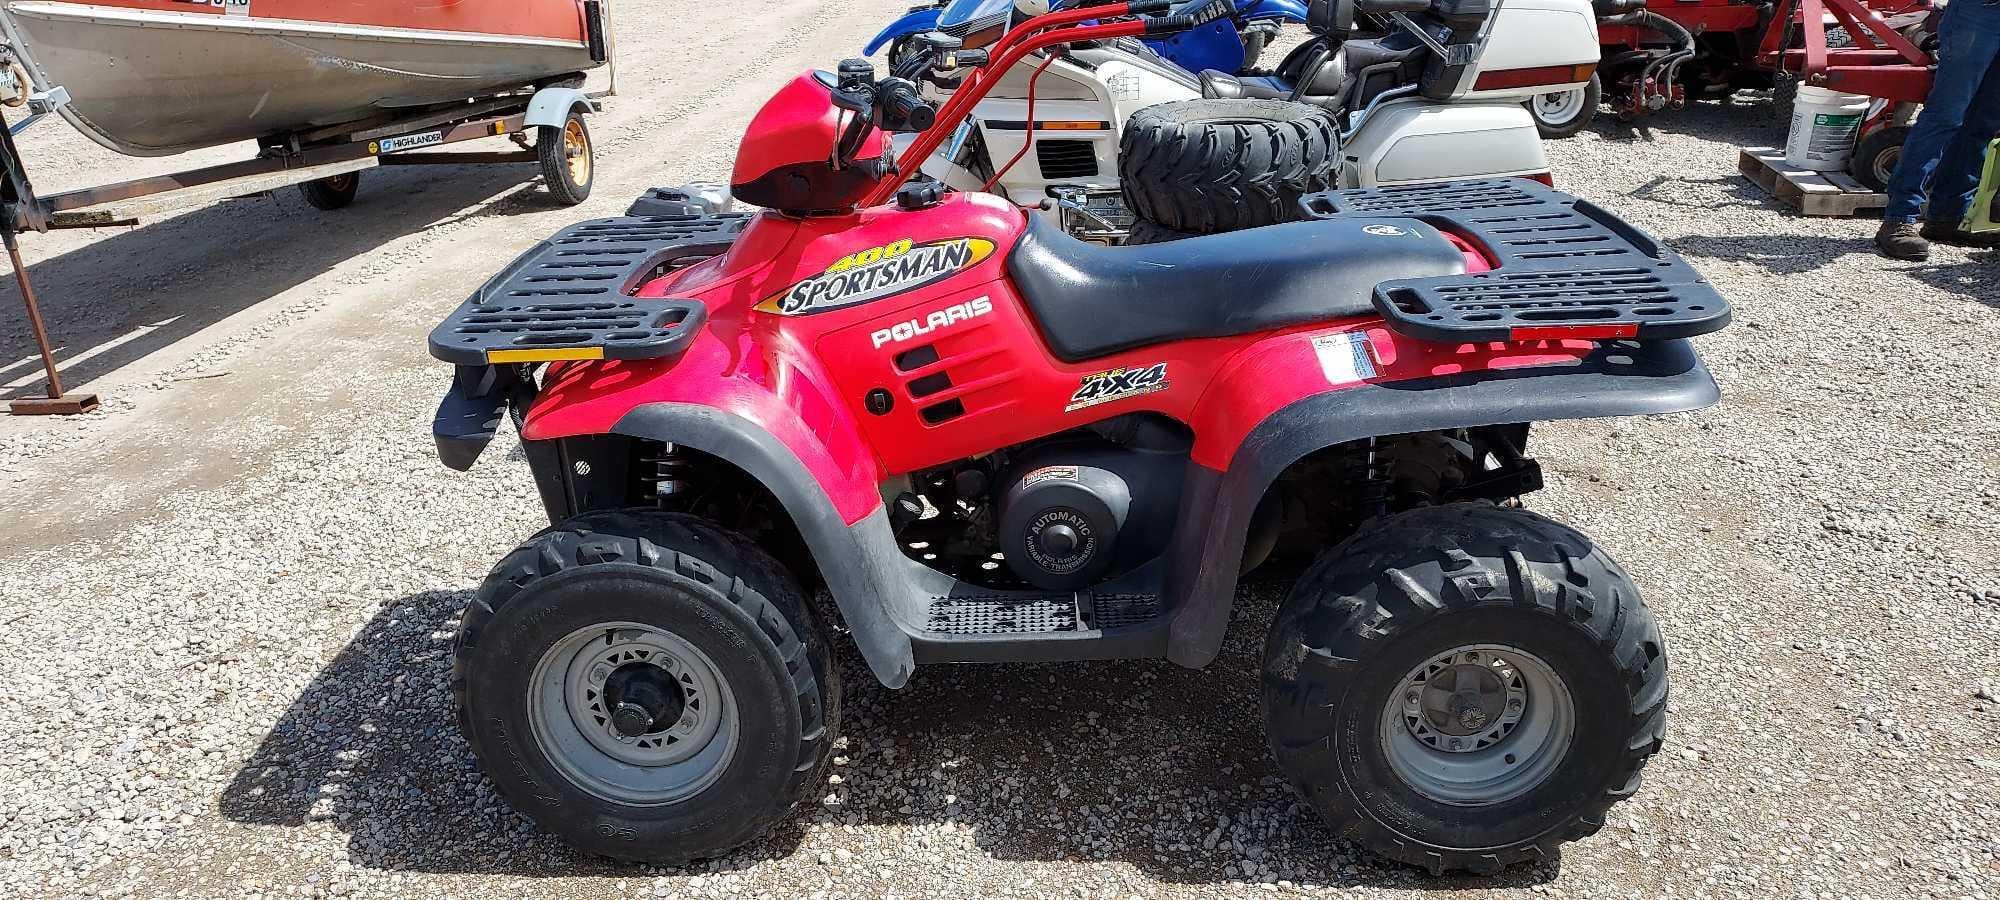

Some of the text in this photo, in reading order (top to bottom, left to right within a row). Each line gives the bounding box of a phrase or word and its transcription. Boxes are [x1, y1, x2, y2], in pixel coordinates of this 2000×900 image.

[393, 133, 441, 148] HIGHLANDER
[825, 237, 913, 273] 400
[783, 238, 969, 313] SPORTSMAN
[870, 295, 993, 349] POLARIS
[1031, 511, 1091, 536] AUTOMATIC
[1026, 535, 1049, 567] VARIABLE
